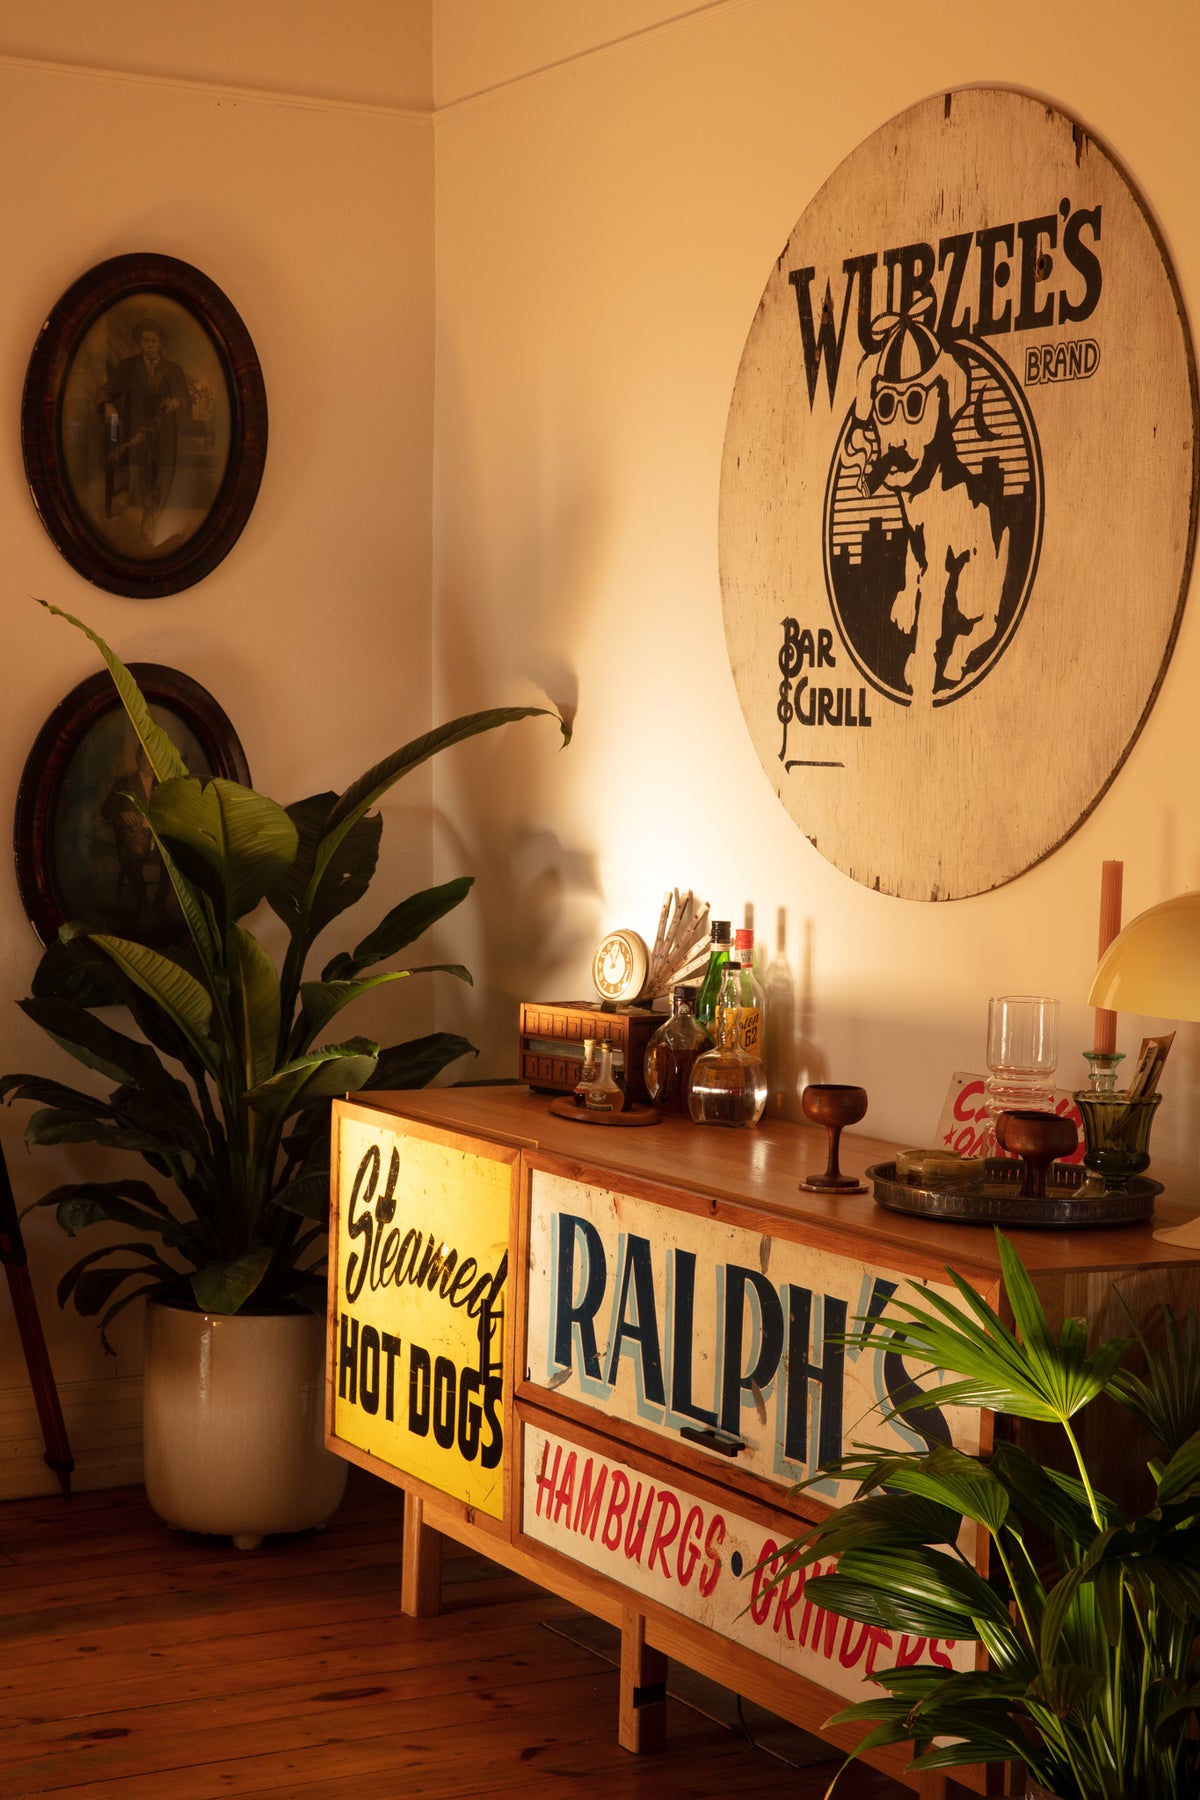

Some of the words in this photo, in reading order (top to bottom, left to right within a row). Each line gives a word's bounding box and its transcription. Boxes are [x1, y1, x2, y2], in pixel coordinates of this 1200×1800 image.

[789, 197, 1102, 415] WUBZEE'S
[1026, 339, 1100, 386] BRAND
[779, 616, 836, 678] BAR
[745, 1026, 758, 1047] 62
[346, 1145, 508, 1342] Steamed
[338, 1312, 401, 1423] HOT
[408, 1343, 504, 1470] DOGS
[547, 1212, 954, 1498] RALPH'S
[535, 1439, 727, 1598] HAMBURGS
